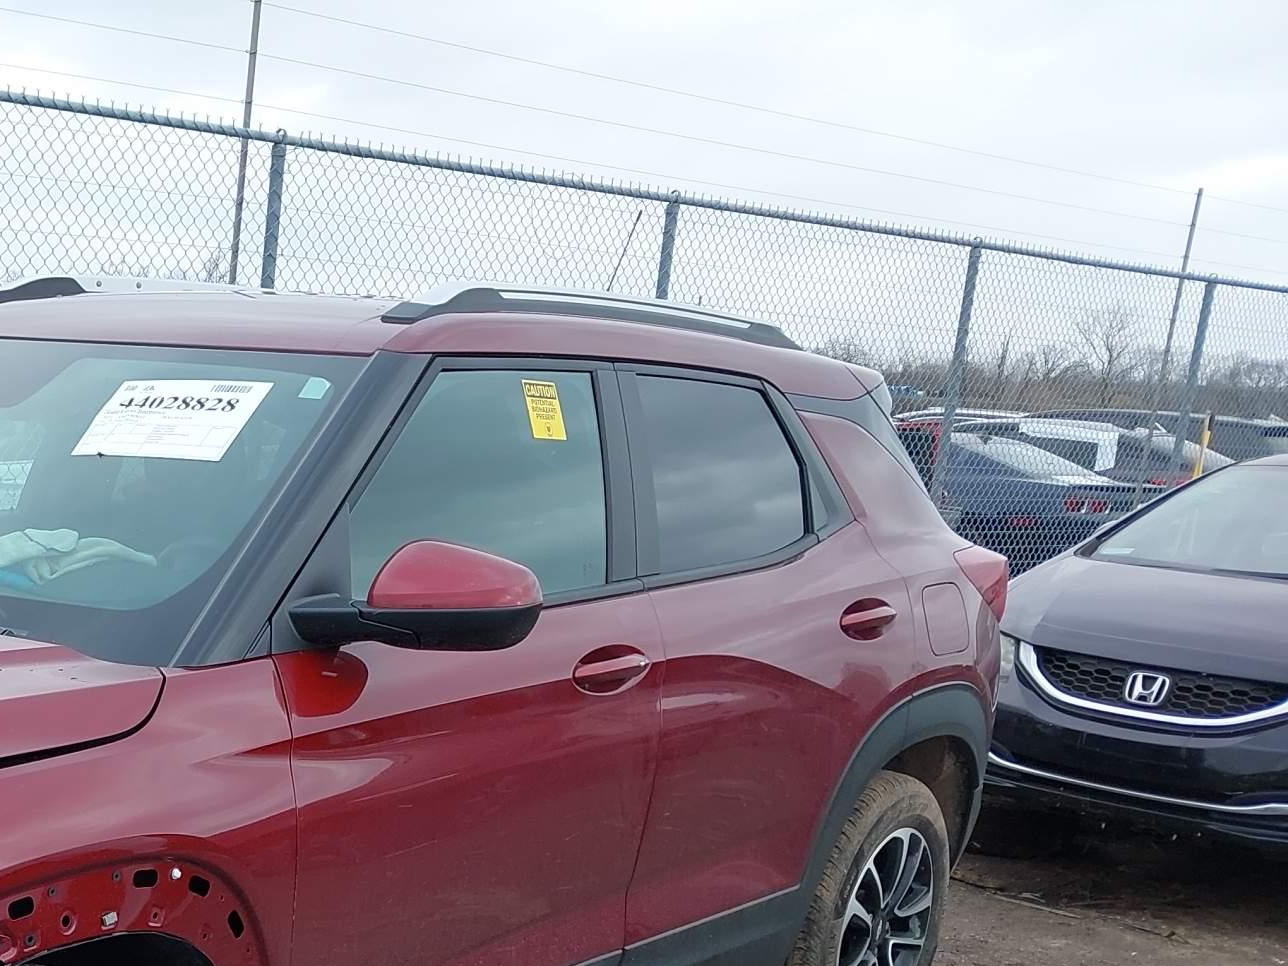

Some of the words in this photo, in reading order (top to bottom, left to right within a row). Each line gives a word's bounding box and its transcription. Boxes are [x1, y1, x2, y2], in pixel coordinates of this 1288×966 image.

[525, 384, 556, 398] CAUTION
[119, 395, 240, 413] 44028828
[535, 413, 556, 421] PRESENT
